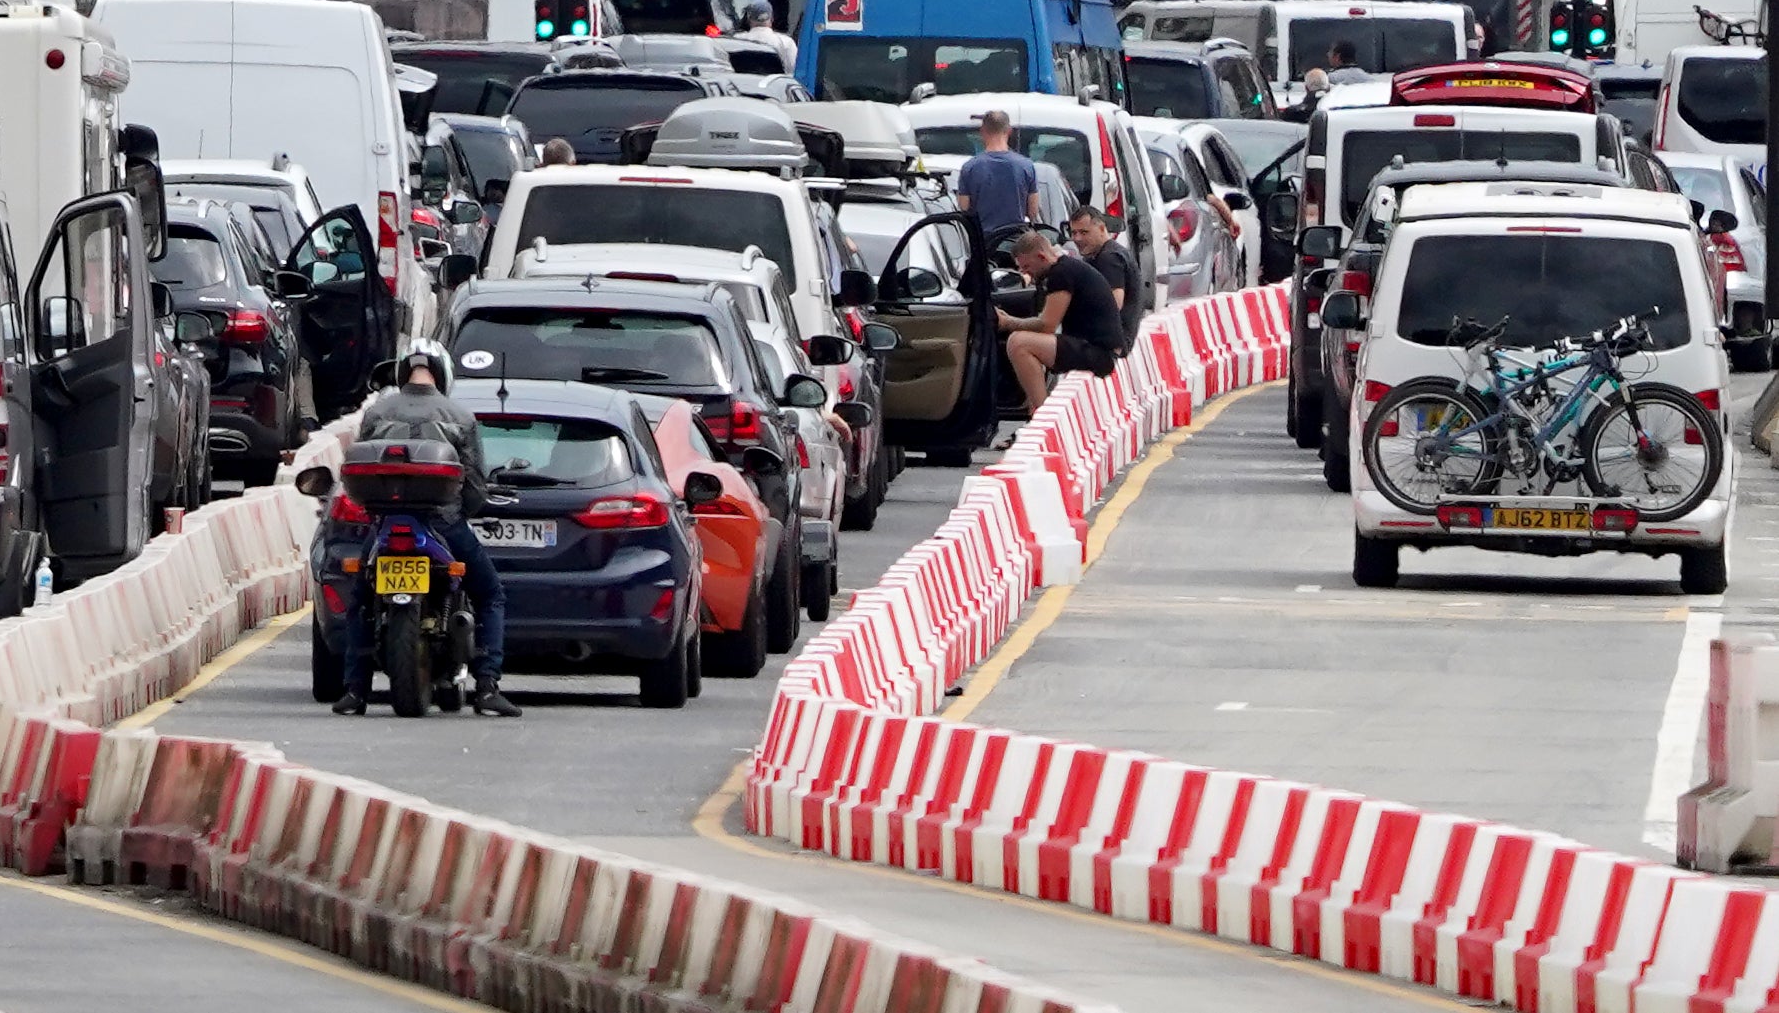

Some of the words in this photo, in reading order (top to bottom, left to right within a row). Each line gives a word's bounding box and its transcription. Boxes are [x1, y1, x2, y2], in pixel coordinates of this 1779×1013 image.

[469, 355, 486, 364] UK
[1497, 510, 1545, 528] AJ62
[1550, 511, 1588, 529] BTZ
[380, 560, 427, 575] WB56
[385, 576, 421, 591] NAX
